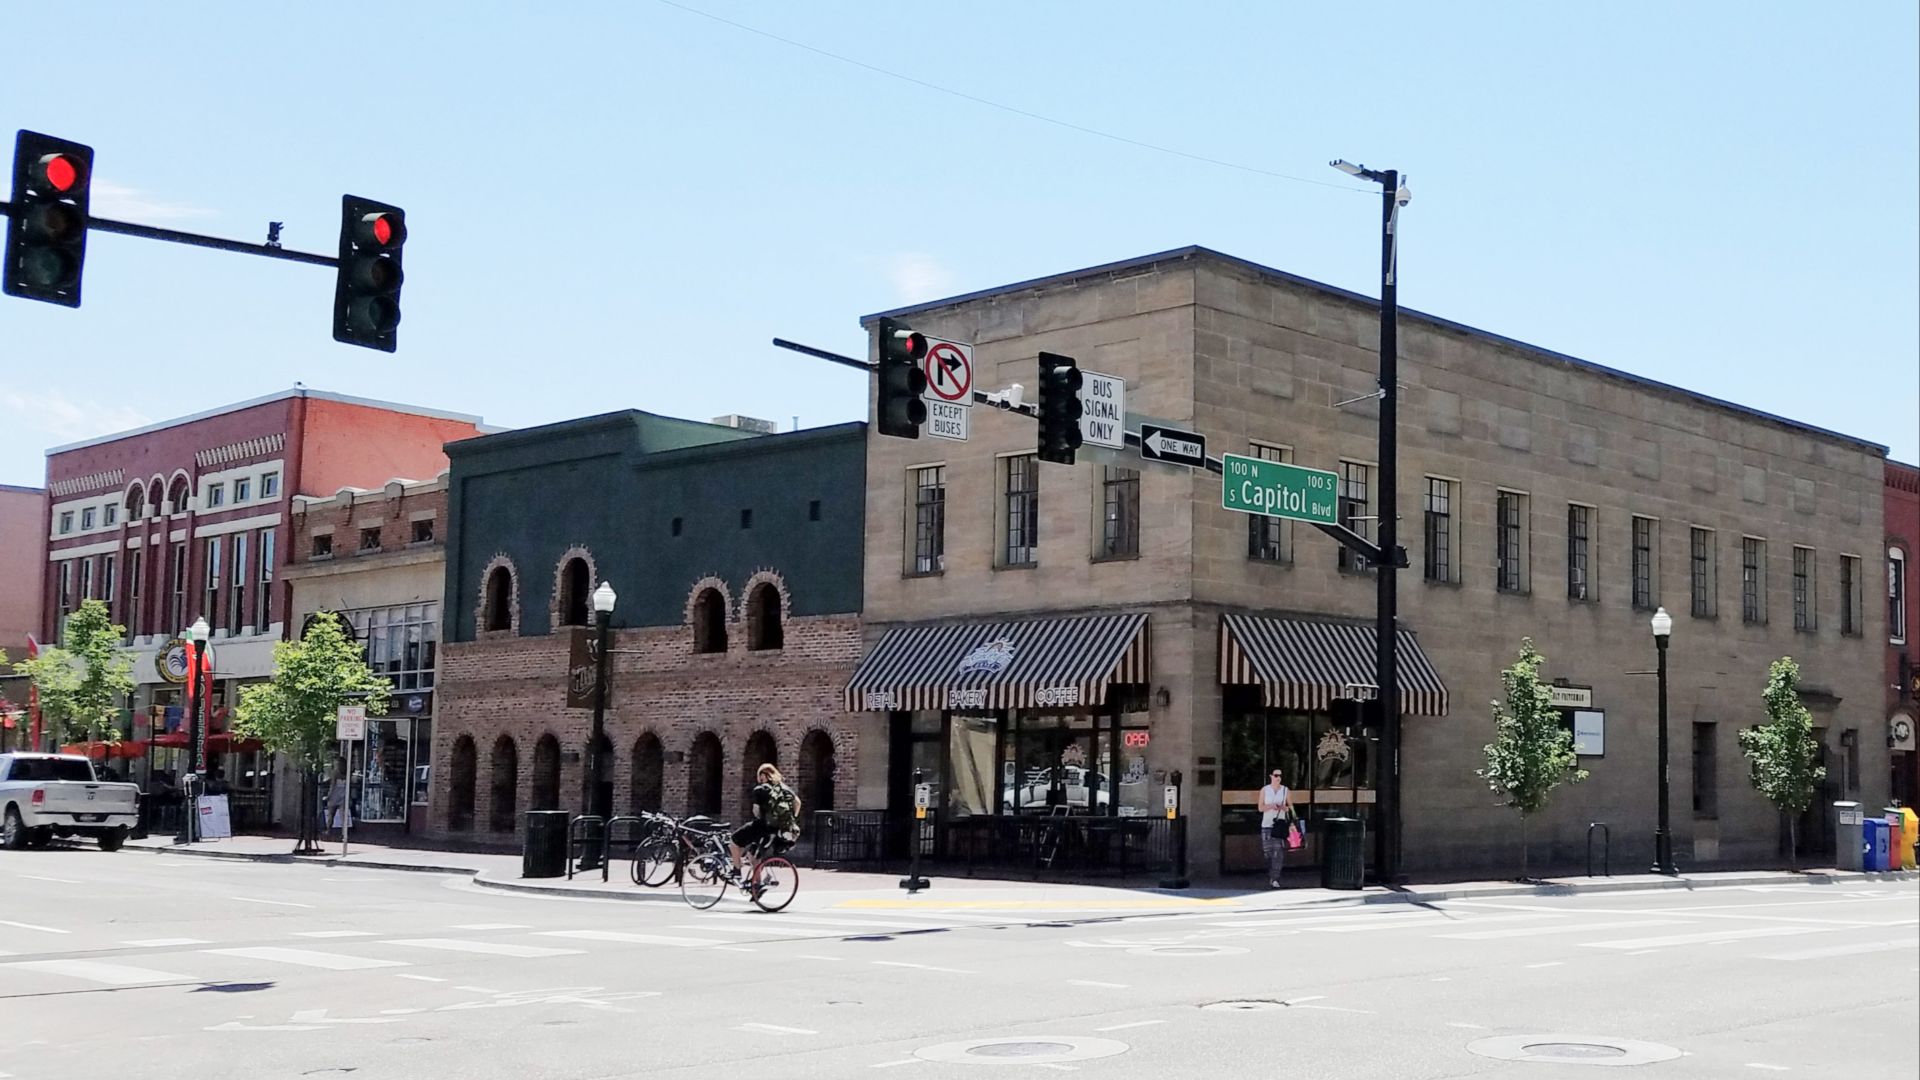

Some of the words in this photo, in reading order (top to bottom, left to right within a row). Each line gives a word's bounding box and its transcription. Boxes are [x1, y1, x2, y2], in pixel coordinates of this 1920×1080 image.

[1093, 379, 1112, 399] BUS
[933, 403, 963, 420] EXCEPT
[1085, 399, 1119, 421] SIGNAL
[935, 419, 961, 436] BUSES
[1089, 421, 1114, 441] ONLY
[1161, 439, 1178, 452] ONE
[1182, 443, 1199, 456] WAY
[1230, 461, 1248, 476] 100
[1251, 465, 1258, 478] N
[1307, 475, 1323, 489] 100
[1326, 478, 1332, 490] S
[1230, 489, 1236, 502] S
[1241, 480, 1307, 514] Capitol
[1312, 502, 1331, 517] Blvd
[867, 691, 898, 708] RETAIL
[949, 689, 988, 707] BAKERY
[1035, 686, 1078, 705] COFFEE
